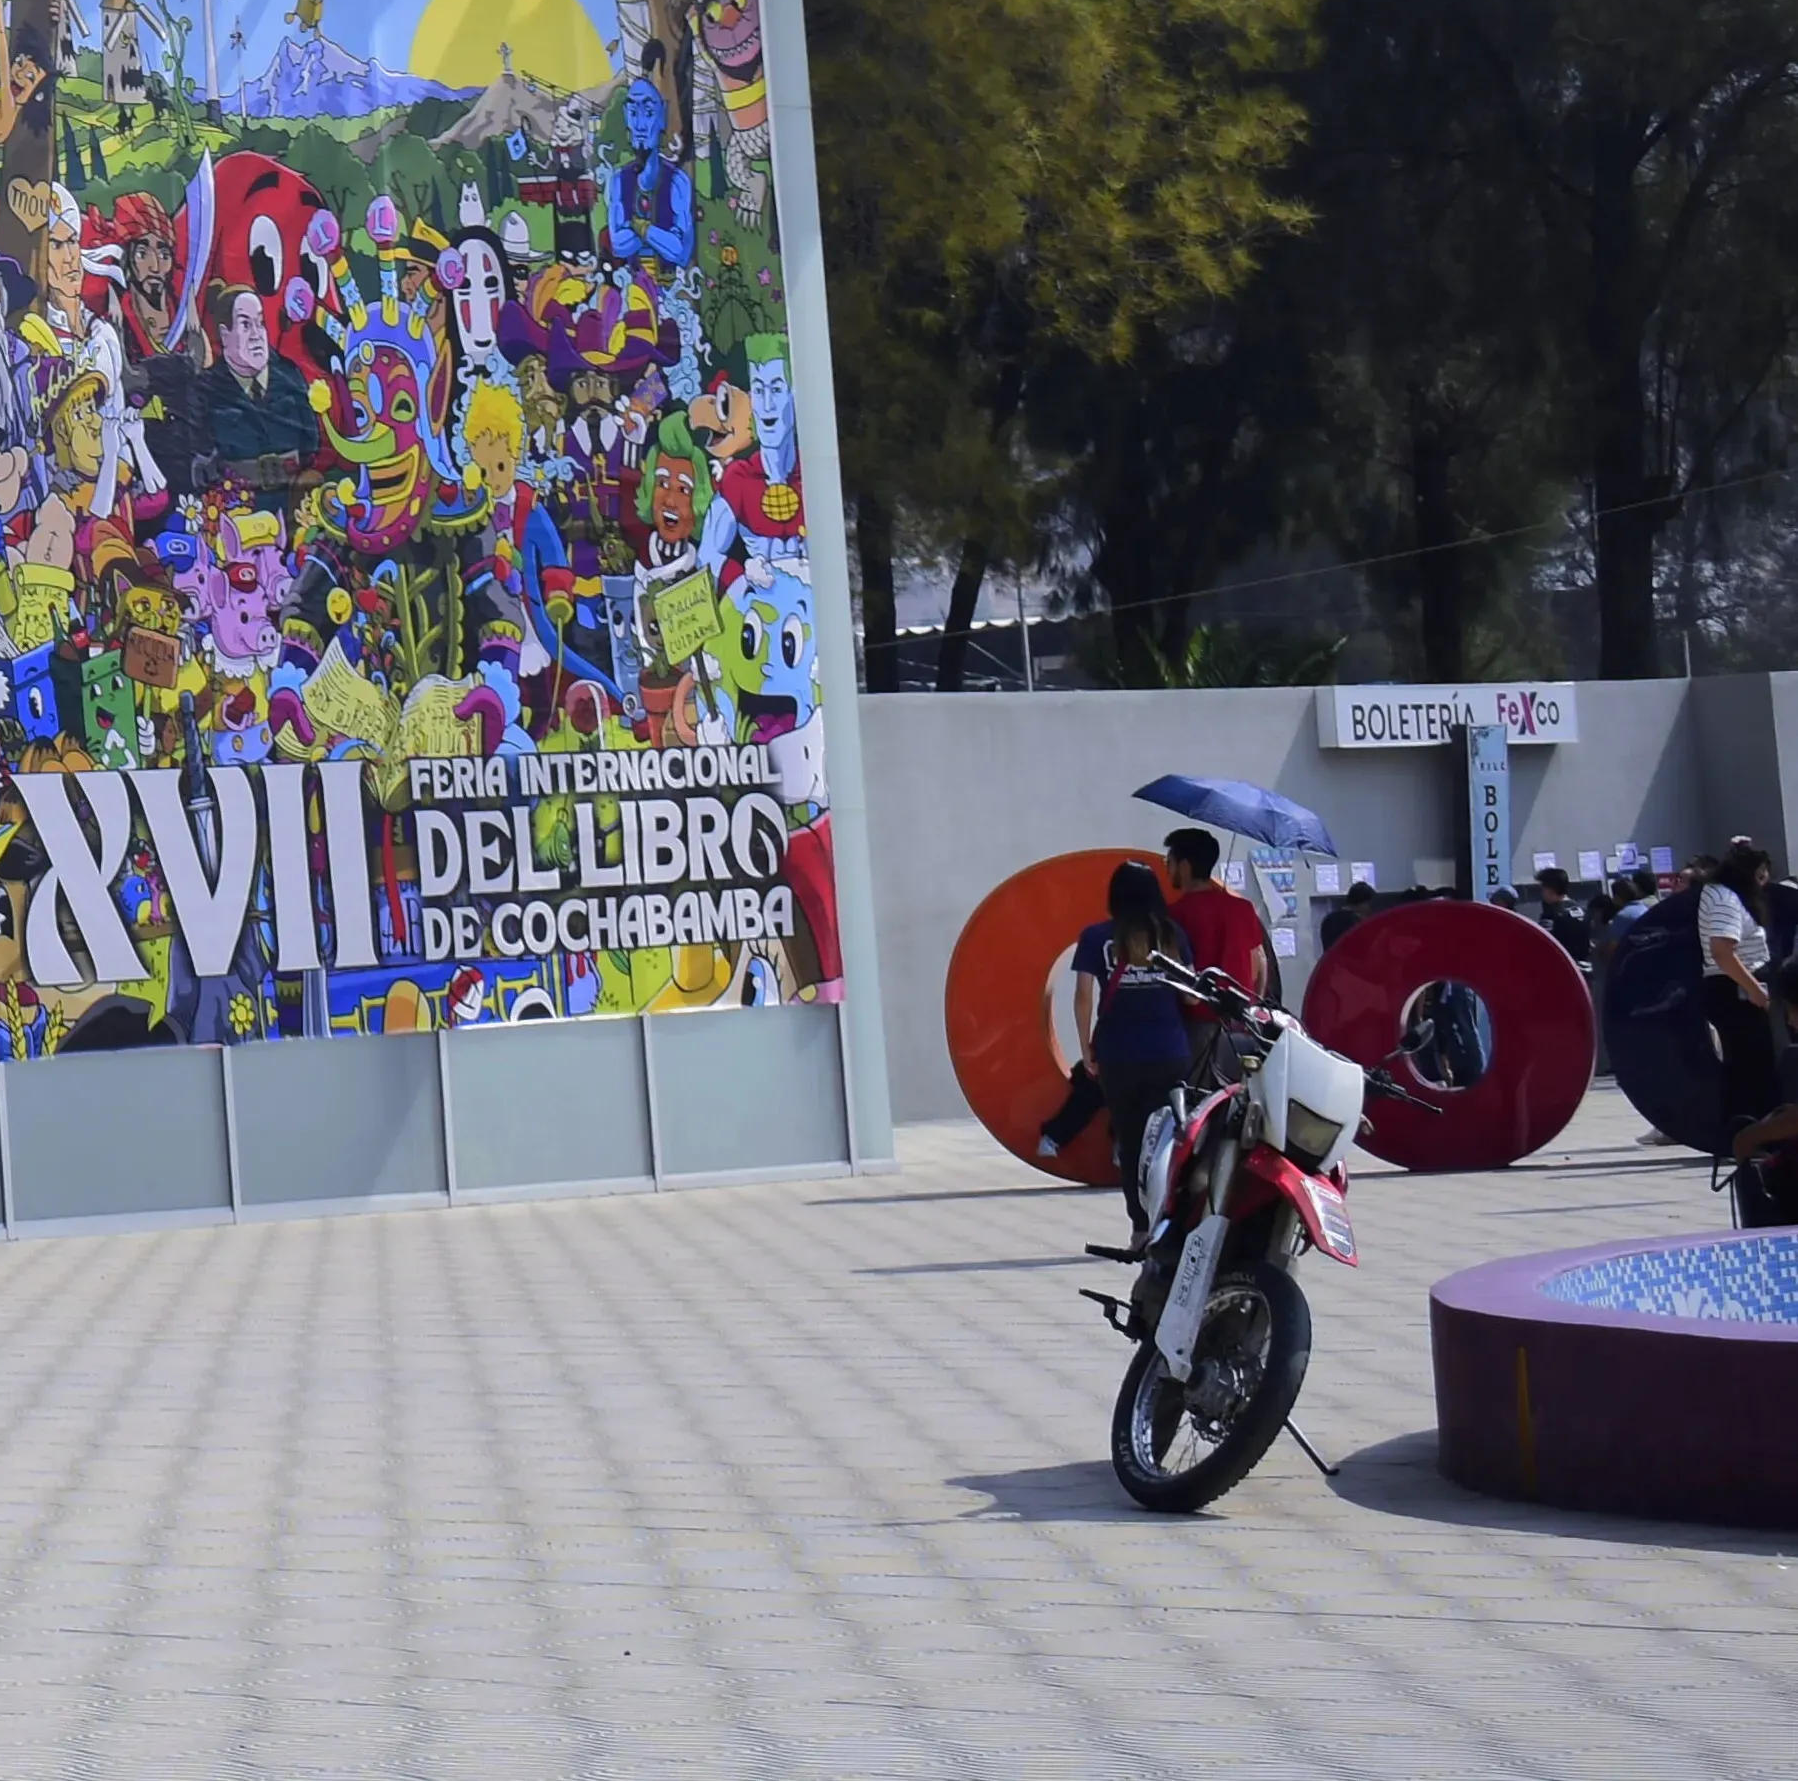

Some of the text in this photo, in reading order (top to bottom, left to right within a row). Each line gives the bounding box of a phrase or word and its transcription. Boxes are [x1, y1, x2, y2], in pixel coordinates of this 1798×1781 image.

[1351, 691, 1475, 741] BOLETERÍA
[410, 744, 782, 800] FERIA INTERNACIONAL
[10, 760, 380, 987] XVII
[413, 792, 789, 897] DEL LIBRO
[421, 905, 484, 961] DE
[491, 885, 795, 956] COCHABAMBA
